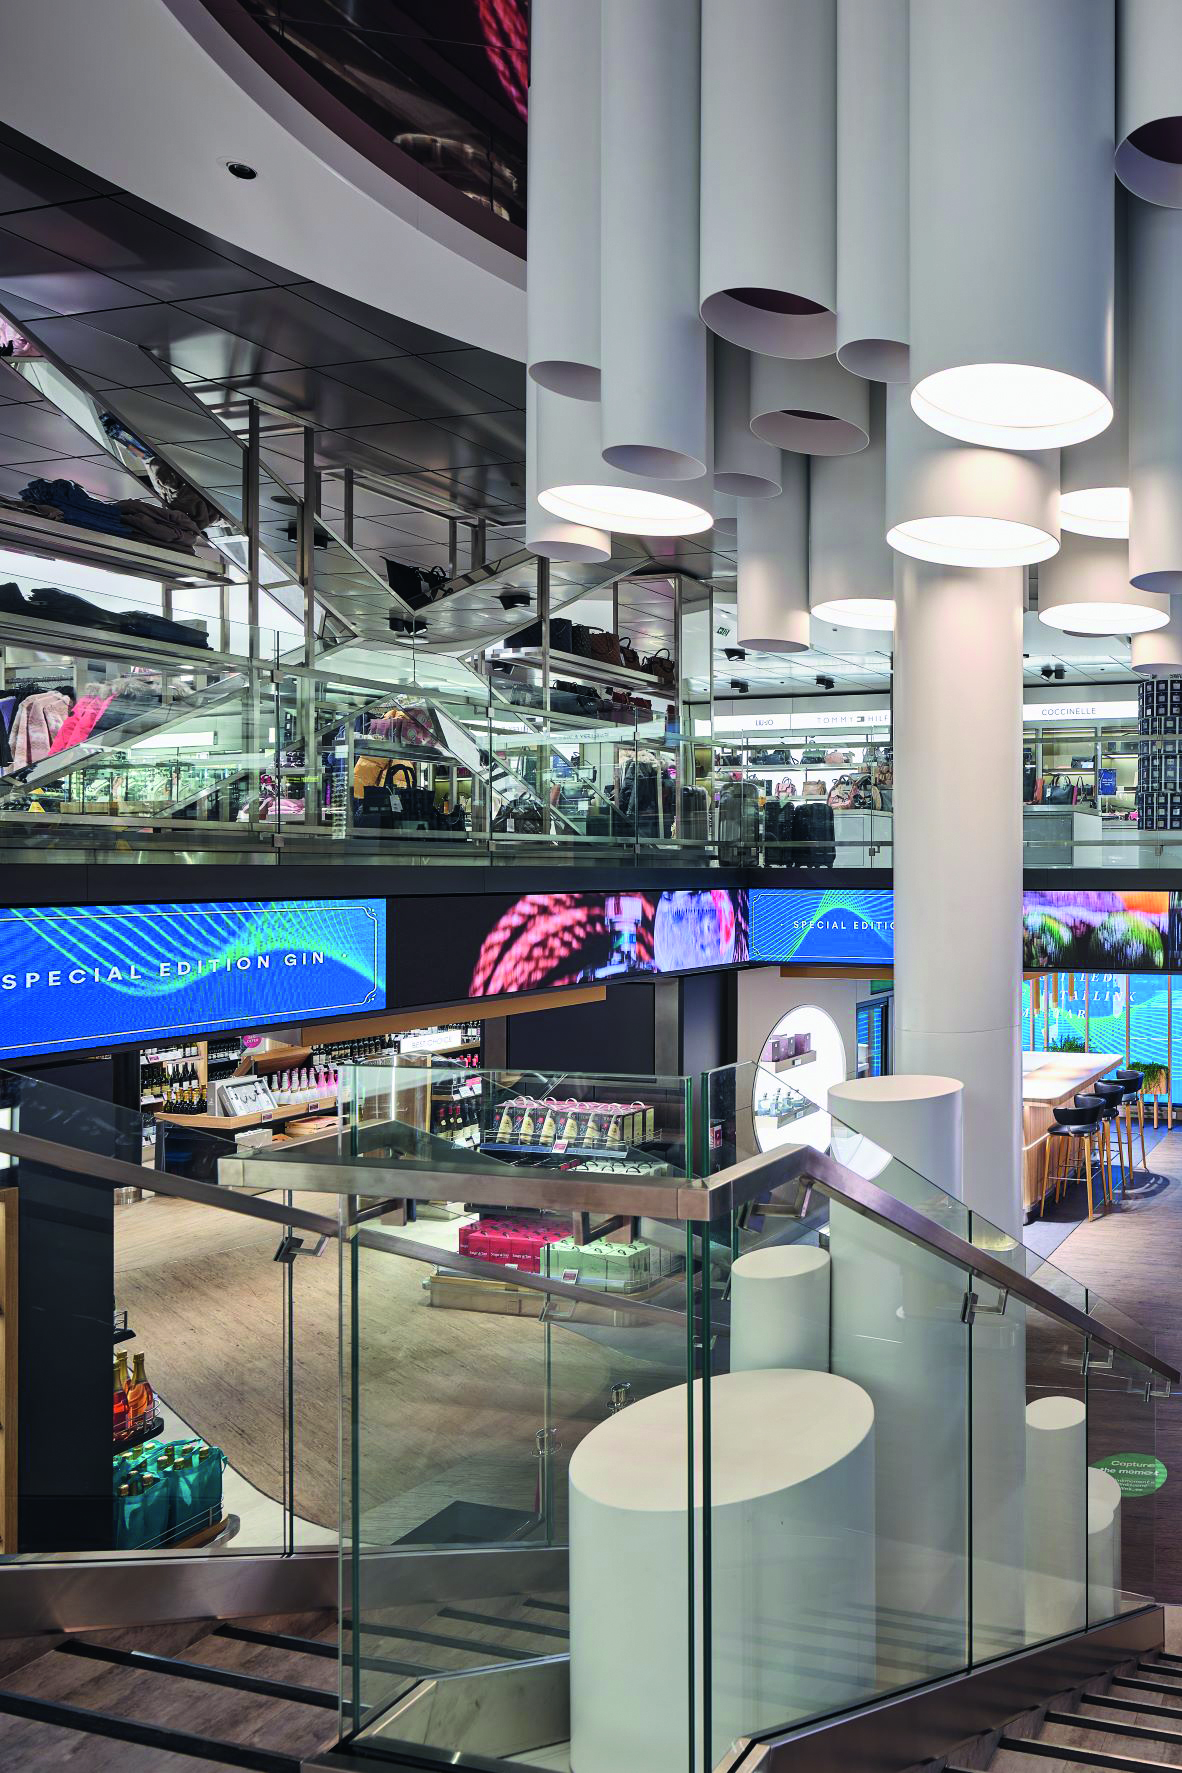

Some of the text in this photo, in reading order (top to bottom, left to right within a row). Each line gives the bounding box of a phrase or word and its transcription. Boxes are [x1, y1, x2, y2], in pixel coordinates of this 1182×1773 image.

[1041, 707, 1097, 716] COCCINELLE
[817, 716, 854, 724] TOMMY
[793, 920, 847, 930] SPECIAL
[1, 951, 325, 990] SPECIAL EDITION GIN
[411, 1041, 427, 1049] BEST
[1111, 1460, 1156, 1468] Capture
